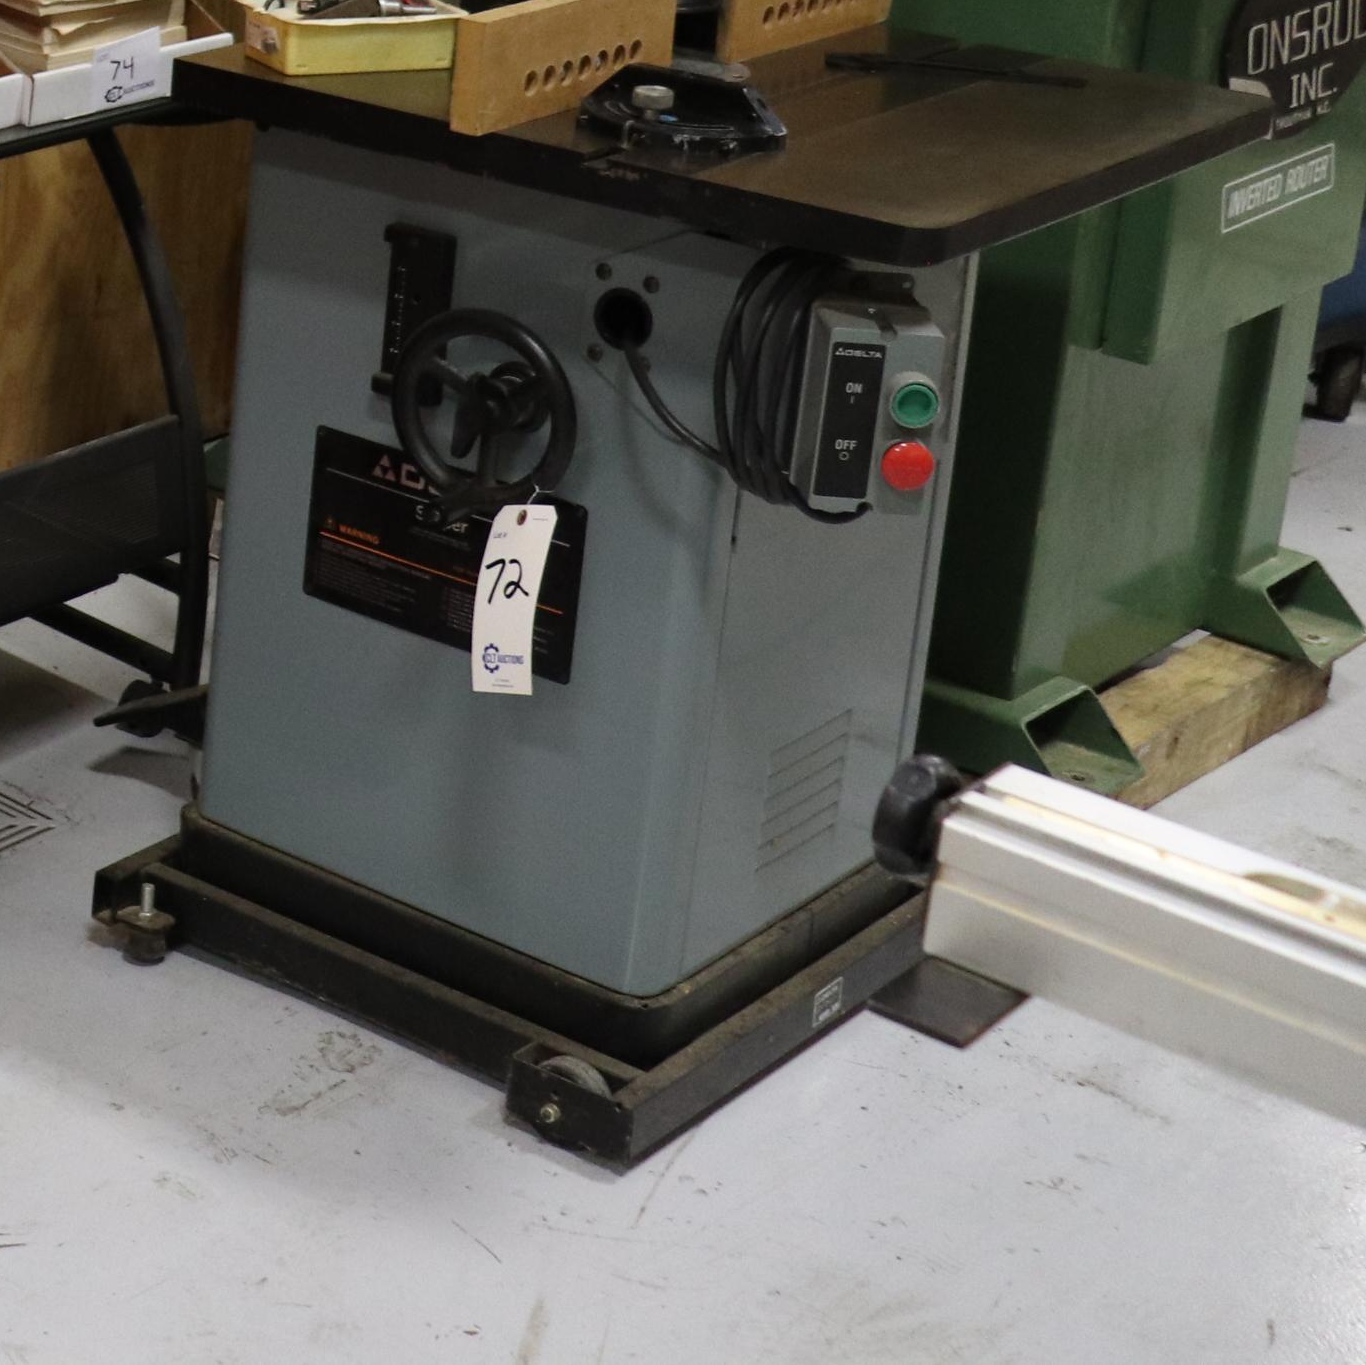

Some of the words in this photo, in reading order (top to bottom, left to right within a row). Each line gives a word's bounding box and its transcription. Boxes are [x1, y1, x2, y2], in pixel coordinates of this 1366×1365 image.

[110, 56, 134, 81] 74
[1289, 61, 1338, 109] INC.
[1227, 173, 1283, 219] INVERTED
[1285, 154, 1330, 194] ROUTER
[844, 348, 883, 359] DELTA
[845, 382, 863, 395] ON
[835, 438, 858, 451] OFF
[339, 523, 380, 545] WARNING
[485, 558, 530, 605] 72
